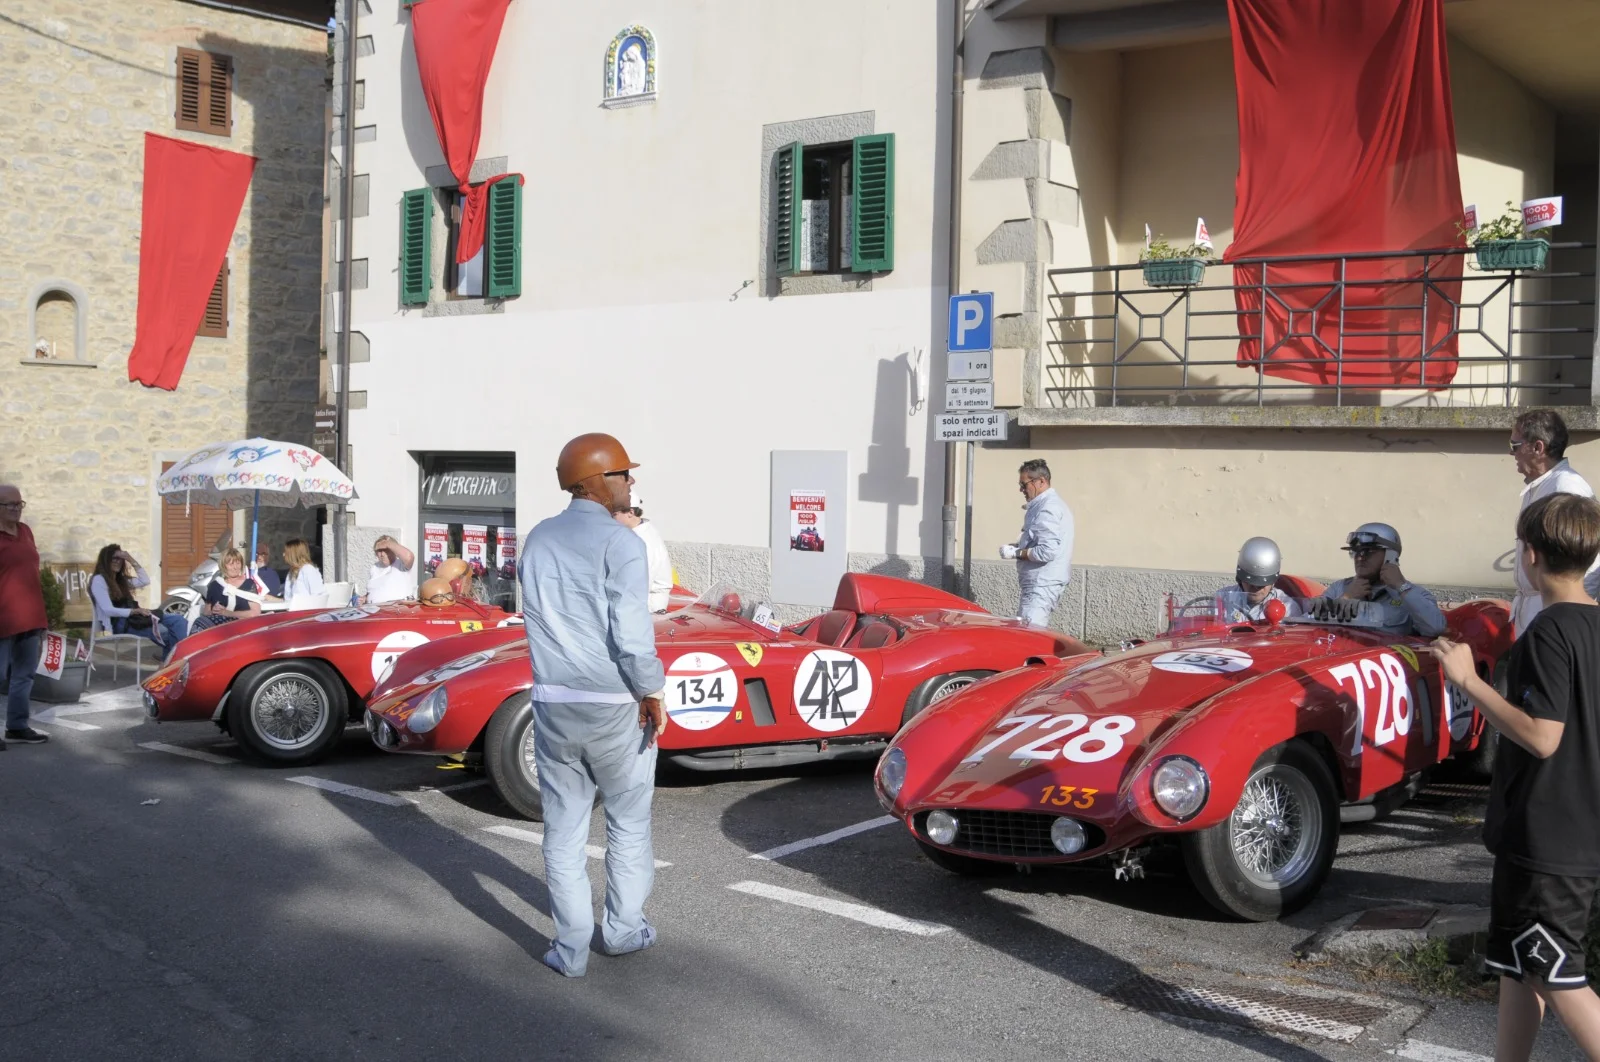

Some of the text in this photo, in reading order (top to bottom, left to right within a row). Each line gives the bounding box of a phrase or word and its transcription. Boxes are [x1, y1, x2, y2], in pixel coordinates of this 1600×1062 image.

[1525, 205, 1548, 215] 1000
[957, 300, 983, 346] P
[968, 362, 972, 370] 1
[969, 387, 987, 395] giugno
[942, 415, 998, 426] solo entro gli
[942, 428, 998, 439] spazi indicati
[53, 639, 61, 665] 1000
[1172, 653, 1235, 667] 133
[676, 677, 725, 706] 134
[799, 660, 859, 720] 42
[384, 700, 415, 722] 134
[1328, 653, 1414, 757] 728
[960, 713, 1136, 763] 728
[1038, 785, 1099, 809] 133
